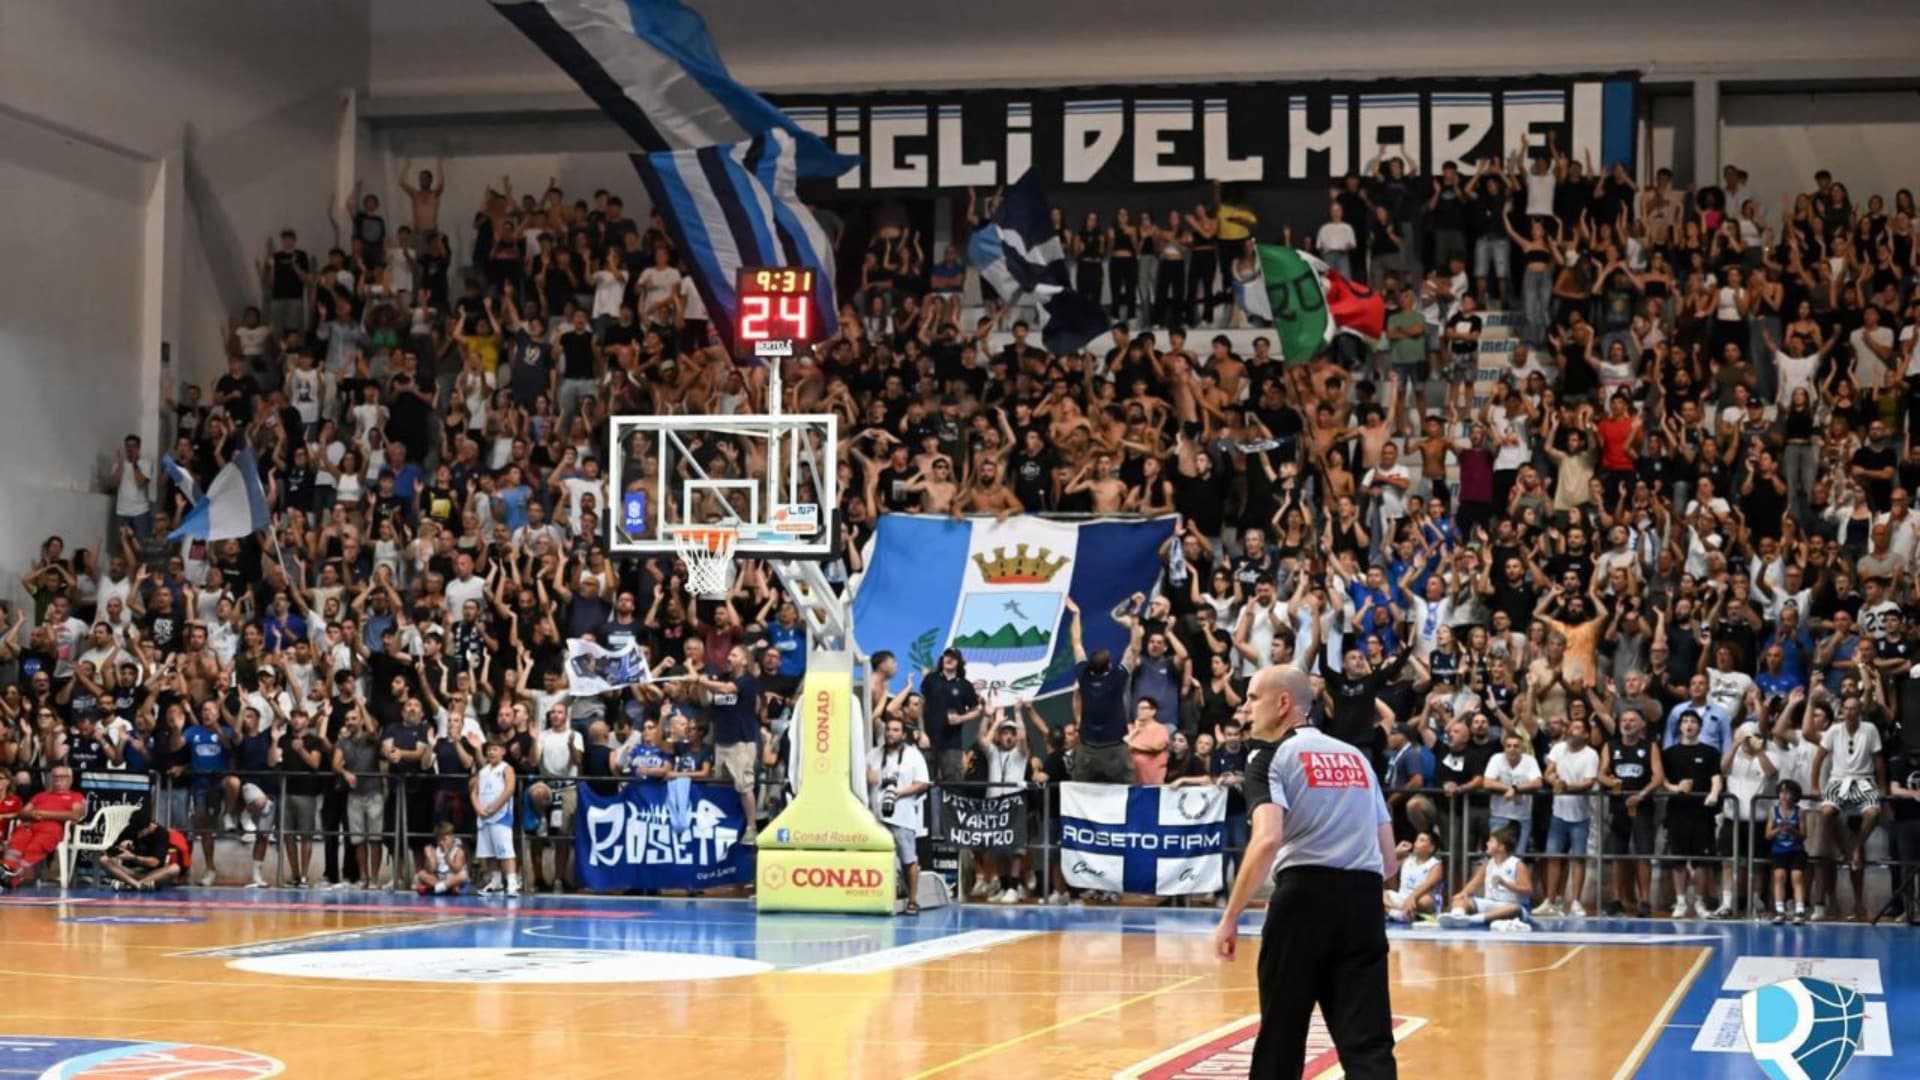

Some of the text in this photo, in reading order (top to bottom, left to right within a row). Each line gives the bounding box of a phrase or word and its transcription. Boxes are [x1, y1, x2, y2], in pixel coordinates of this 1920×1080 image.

[1063, 99, 1264, 183] DEL
[757, 271, 811, 292] 9:31
[742, 296, 807, 339] 24
[816, 690, 830, 754] CONAD
[1313, 769, 1363, 780] GROUP
[957, 810, 1009, 830] VANTO
[793, 829, 828, 842] Conad
[830, 831, 870, 843] Roseto
[950, 827, 1015, 847] NOSTRO
[1063, 824, 1221, 850] ROSETO FIRM
[792, 867, 884, 888] CONAD
